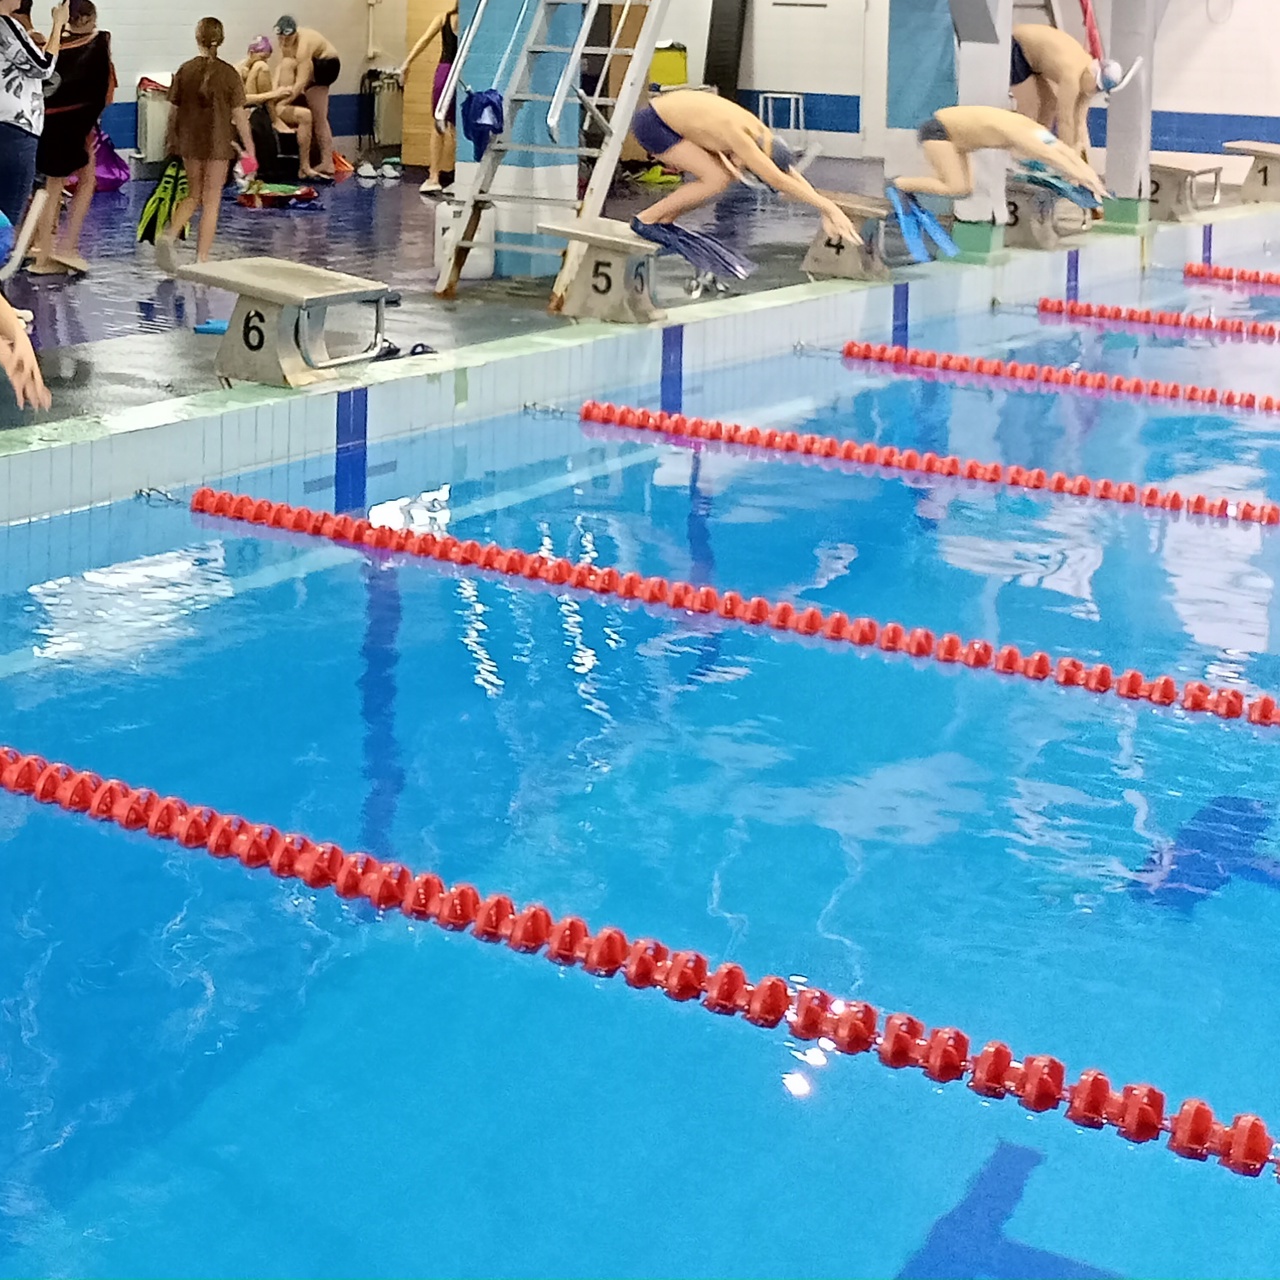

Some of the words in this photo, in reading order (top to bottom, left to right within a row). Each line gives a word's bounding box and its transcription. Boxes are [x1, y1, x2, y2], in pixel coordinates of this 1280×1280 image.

[1258, 165, 1268, 186] 1
[1005, 201, 1019, 226] 3
[824, 233, 845, 256] 4
[592, 260, 612, 295] 5
[634, 261, 645, 295] 5
[243, 309, 265, 351] 6
